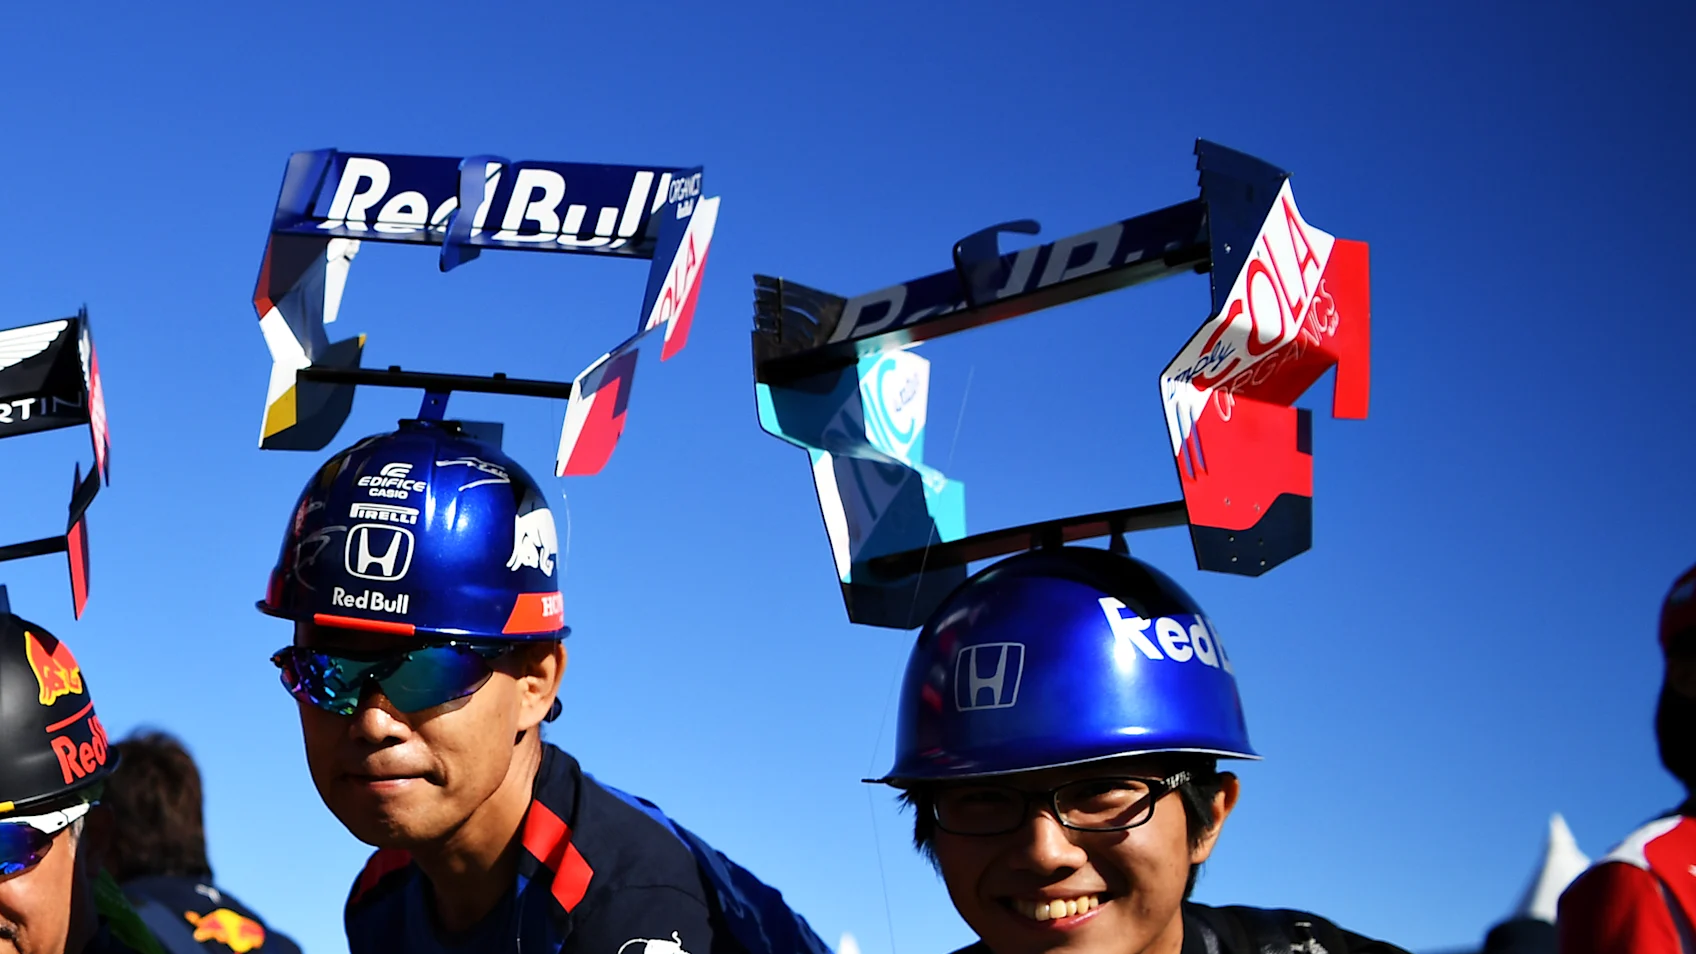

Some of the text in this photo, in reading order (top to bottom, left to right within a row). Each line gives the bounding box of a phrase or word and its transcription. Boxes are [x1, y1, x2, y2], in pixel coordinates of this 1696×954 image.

[317, 157, 671, 250] Red Bull
[1191, 196, 1321, 391] COLA
[357, 475, 427, 493] EDIFICE
[368, 487, 409, 500] CASIO
[349, 502, 420, 525] PIRELLI
[331, 587, 410, 615] Red Bull
[50, 715, 108, 785] Red
